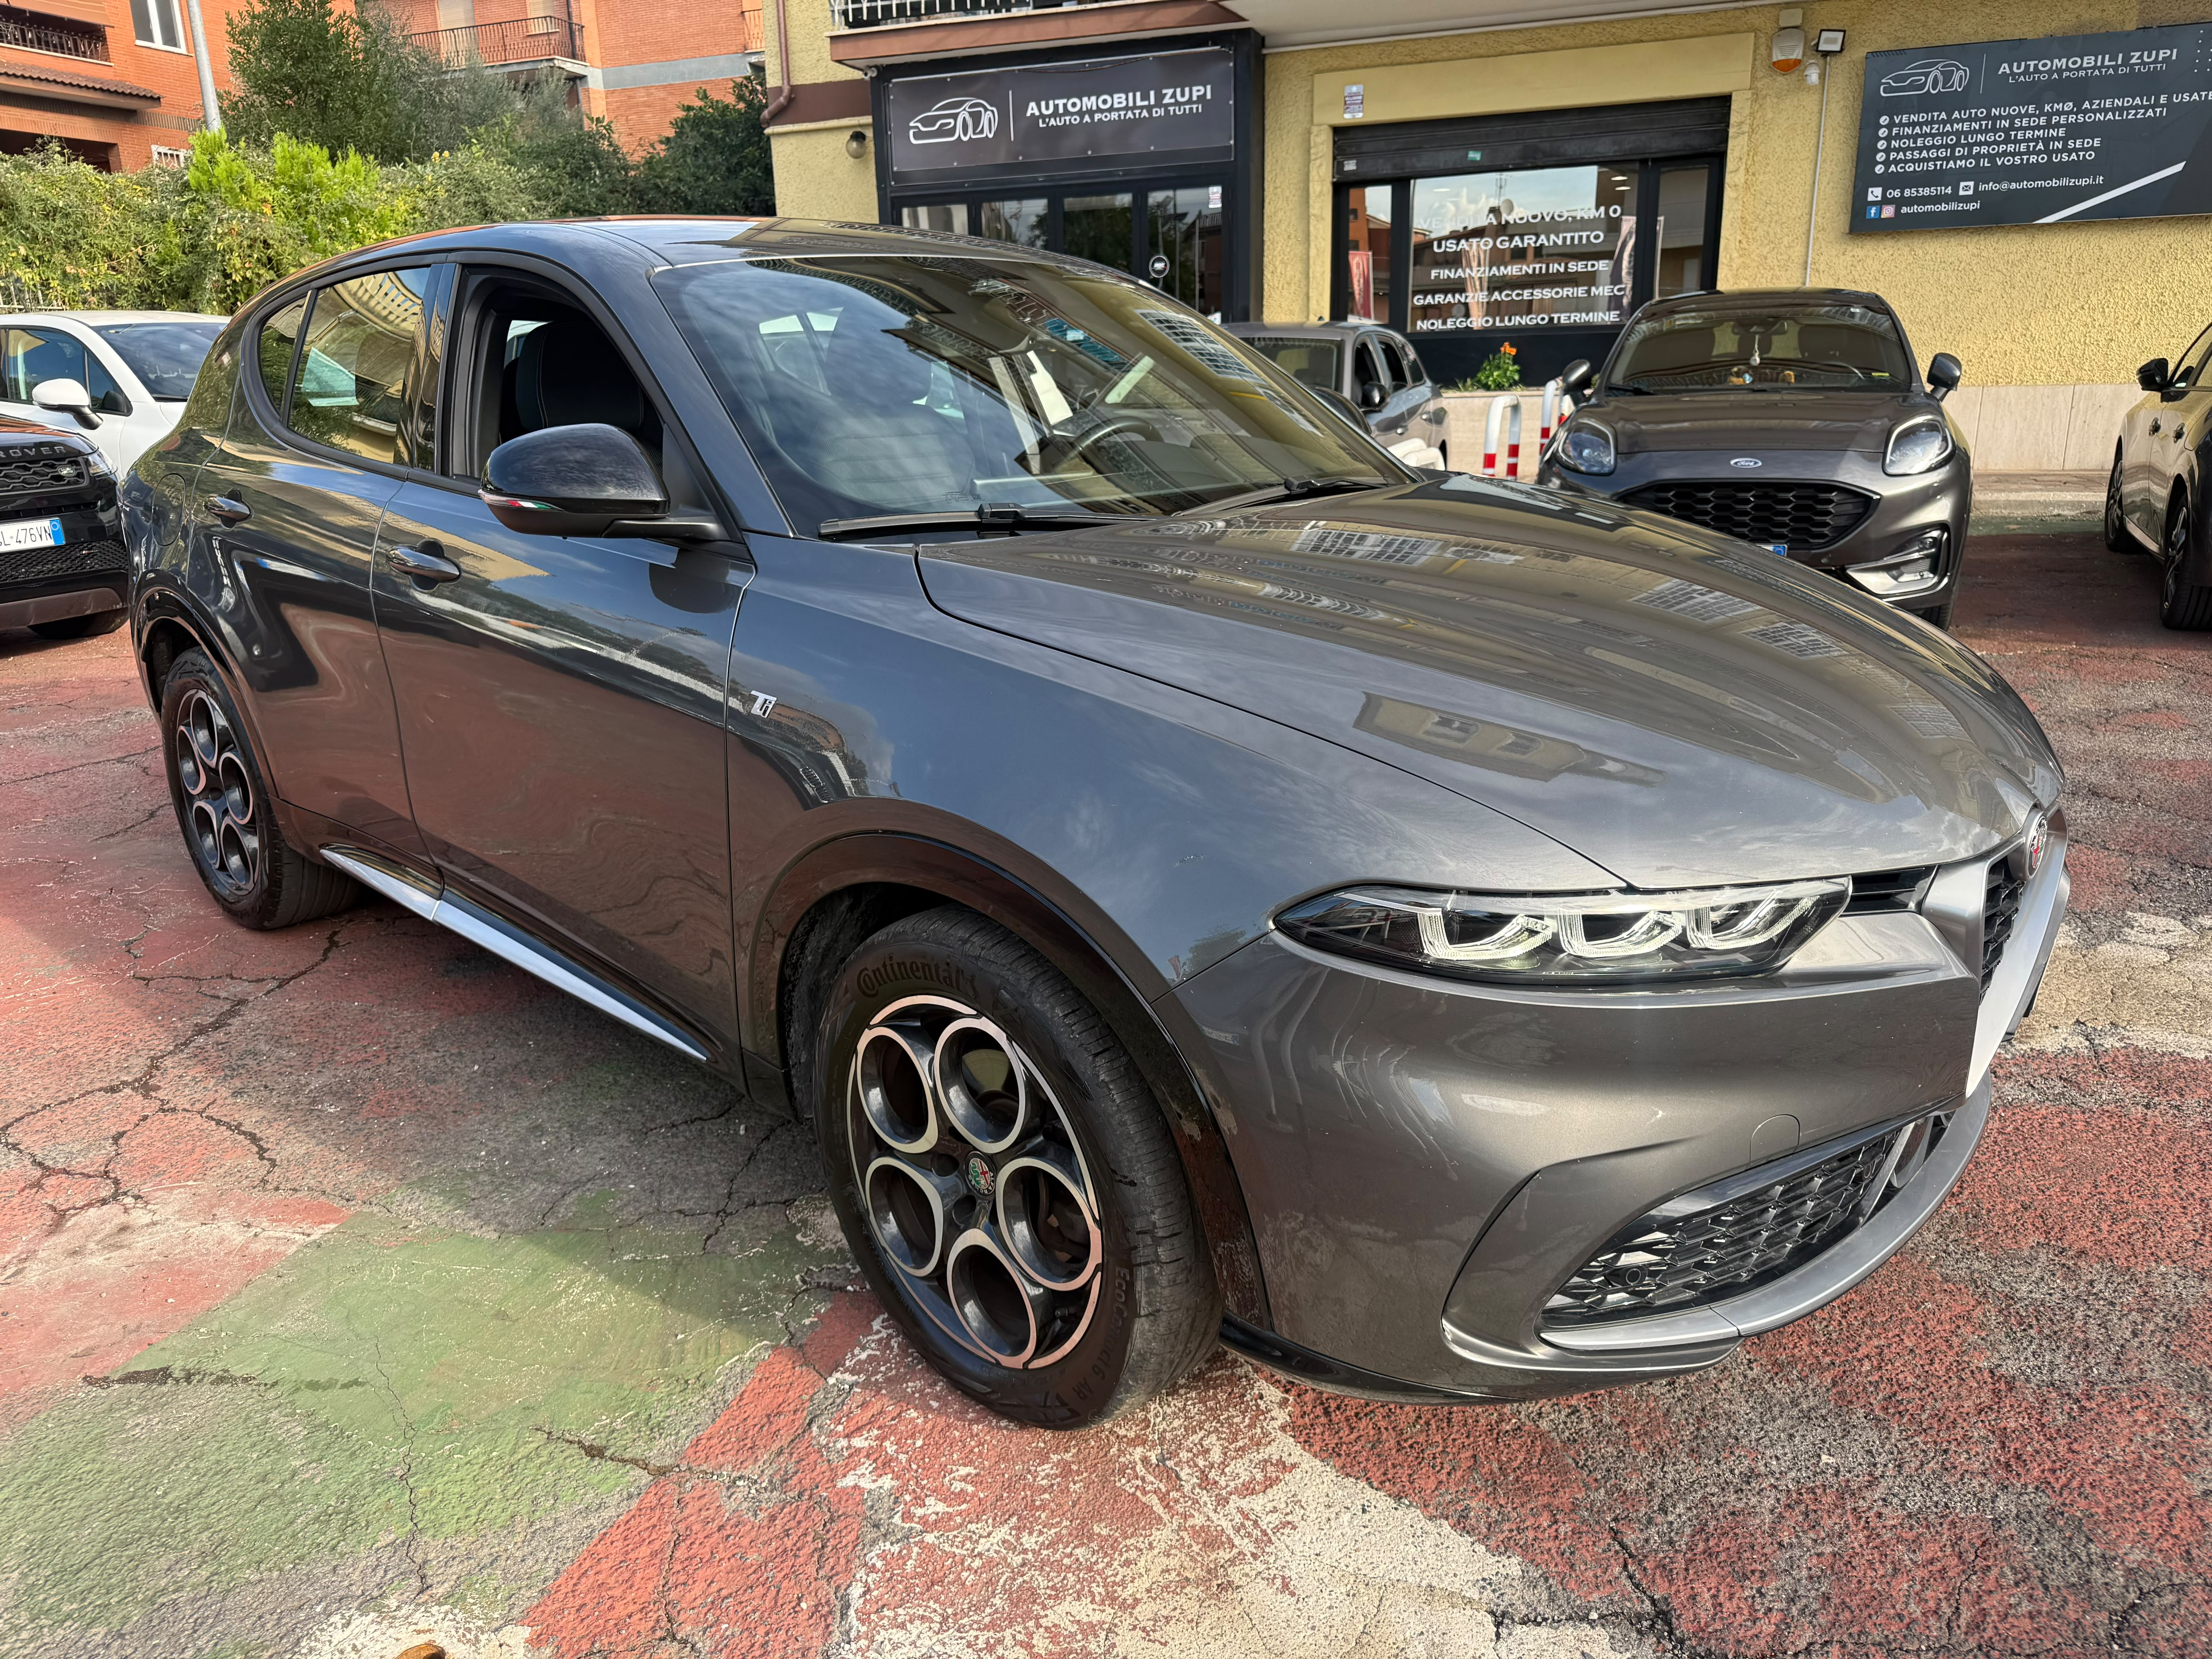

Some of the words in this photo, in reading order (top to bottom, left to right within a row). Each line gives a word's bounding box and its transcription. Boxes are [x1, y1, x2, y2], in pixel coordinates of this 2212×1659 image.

[1998, 53, 2123, 74] AUTOMOBILI
[2129, 48, 2178, 64] ZUPI
[2009, 73, 2048, 83] L'AUTO
[2063, 68, 2115, 79] PORTATA
[2134, 63, 2166, 73] TUTTI
[1026, 90, 1155, 117] AUTOMOBILI
[1162, 85, 1212, 104] ZUPI
[1894, 111, 1947, 124] VENDITA
[1952, 108, 1987, 120] AUTO
[1991, 105, 2040, 117] NUOVE,
[2082, 95, 2155, 110] AZIENDALI
[2160, 94, 2168, 104] E
[1039, 116, 1080, 127] L'AUTO
[1083, 115, 1091, 124] A
[1094, 109, 1149, 122] PORTATA
[1152, 107, 1164, 117] DI
[1168, 104, 1202, 115] TUTTI
[1892, 120, 1992, 136] FINANZIAMENTI
[1996, 119, 2010, 128] IN
[2014, 116, 2048, 127] SEDE
[2052, 107, 2167, 124] PERSONALIZZATI
[1891, 135, 1957, 149] NOLEGGIO
[1961, 132, 2005, 143] LUNGO
[2010, 127, 2066, 140] TERMINE
[1890, 148, 1951, 161] PASSAGGI
[1955, 147, 1968, 156] DI
[1973, 140, 2044, 155] PROPRIETÀ
[2049, 140, 2063, 150] IN
[2067, 138, 2102, 149] SEDE
[1888, 159, 1976, 173] ACQUISTIAMO
[1980, 158, 1991, 167] IL
[1996, 154, 2048, 166] VOSTRO
[2052, 151, 2095, 162] USATO
[1886, 188, 1901, 199] 06
[1904, 185, 1952, 198] 85385114
[1978, 175, 2104, 192] info@automobilizupi.it
[1501, 209, 1573, 225] NUOVO,
[1576, 206, 1605, 219] KM
[1901, 200, 1981, 214] automobilizupi
[1433, 237, 1494, 253] USATO
[1496, 230, 1605, 249] GARANTITO
[1430, 262, 1546, 280] FINANZIAMENTI
[1549, 261, 1565, 273] IN
[1567, 259, 1609, 272] SEDE
[1413, 290, 1489, 306] GARANZIE
[1491, 286, 1588, 302] ACCESSORIE
[1590, 284, 1626, 297] MEC
[1416, 316, 1494, 331] NOLEGGIO
[1495, 314, 1549, 327] LUNGO
[1551, 310, 1621, 324] TERMINE
[0, 531, 11, 546] L
[16, 525, 52, 544] 476VN
[856, 953, 963, 998] Continental
